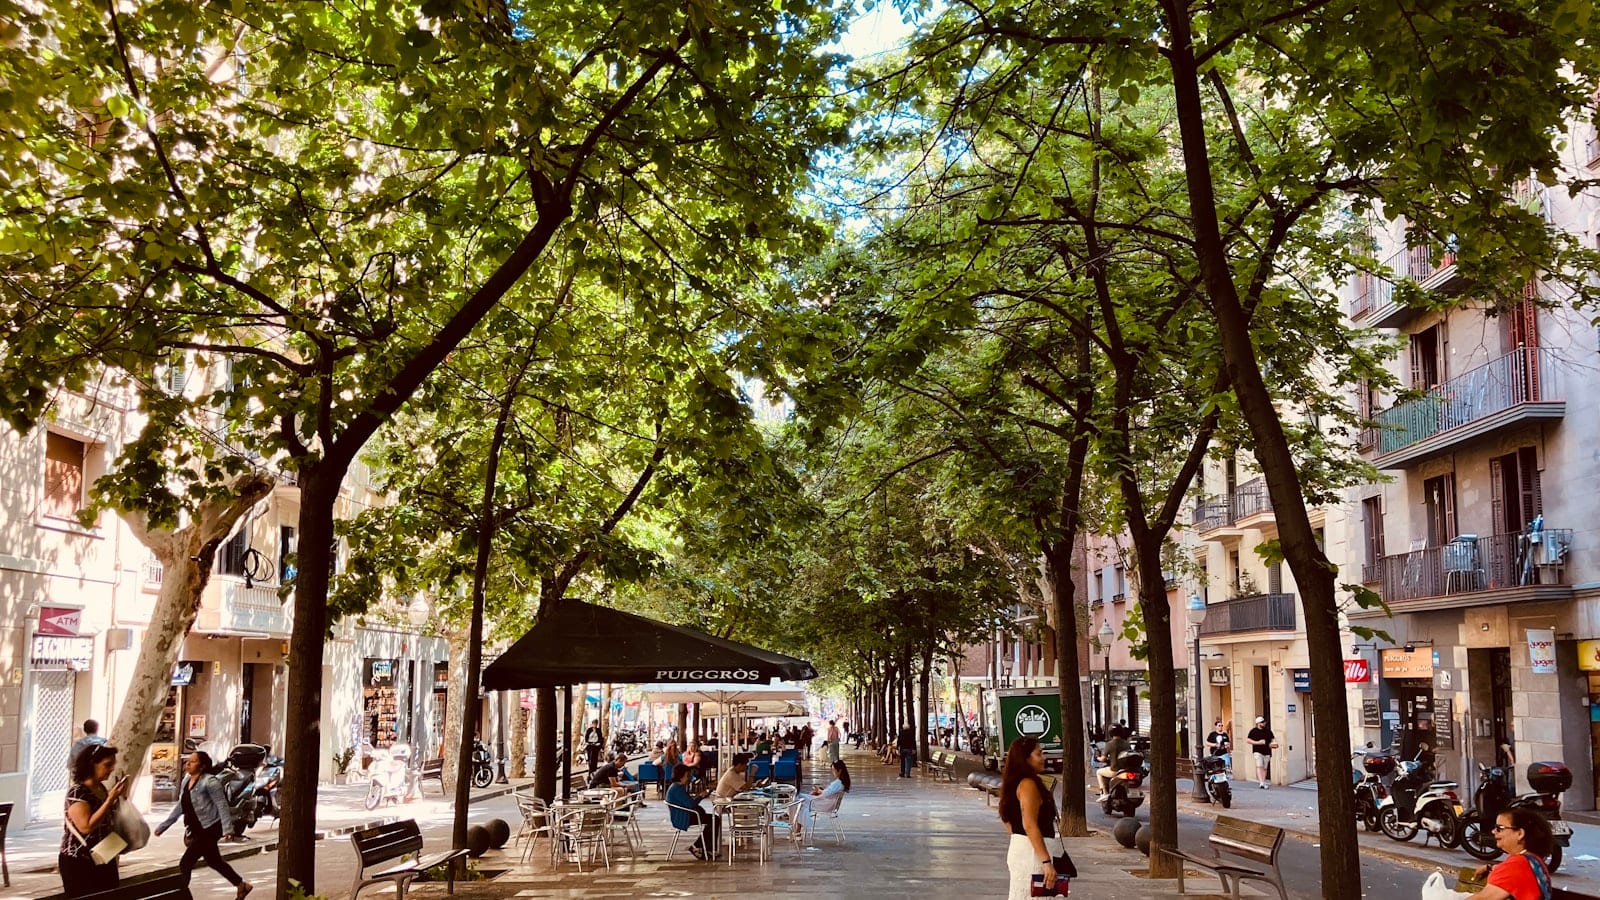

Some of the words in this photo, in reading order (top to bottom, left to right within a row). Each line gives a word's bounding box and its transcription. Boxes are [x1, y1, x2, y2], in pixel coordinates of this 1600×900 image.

[56, 617, 78, 626] ATM
[655, 667, 760, 681] PUIGGRÒS
[1345, 662, 1367, 681] illy
